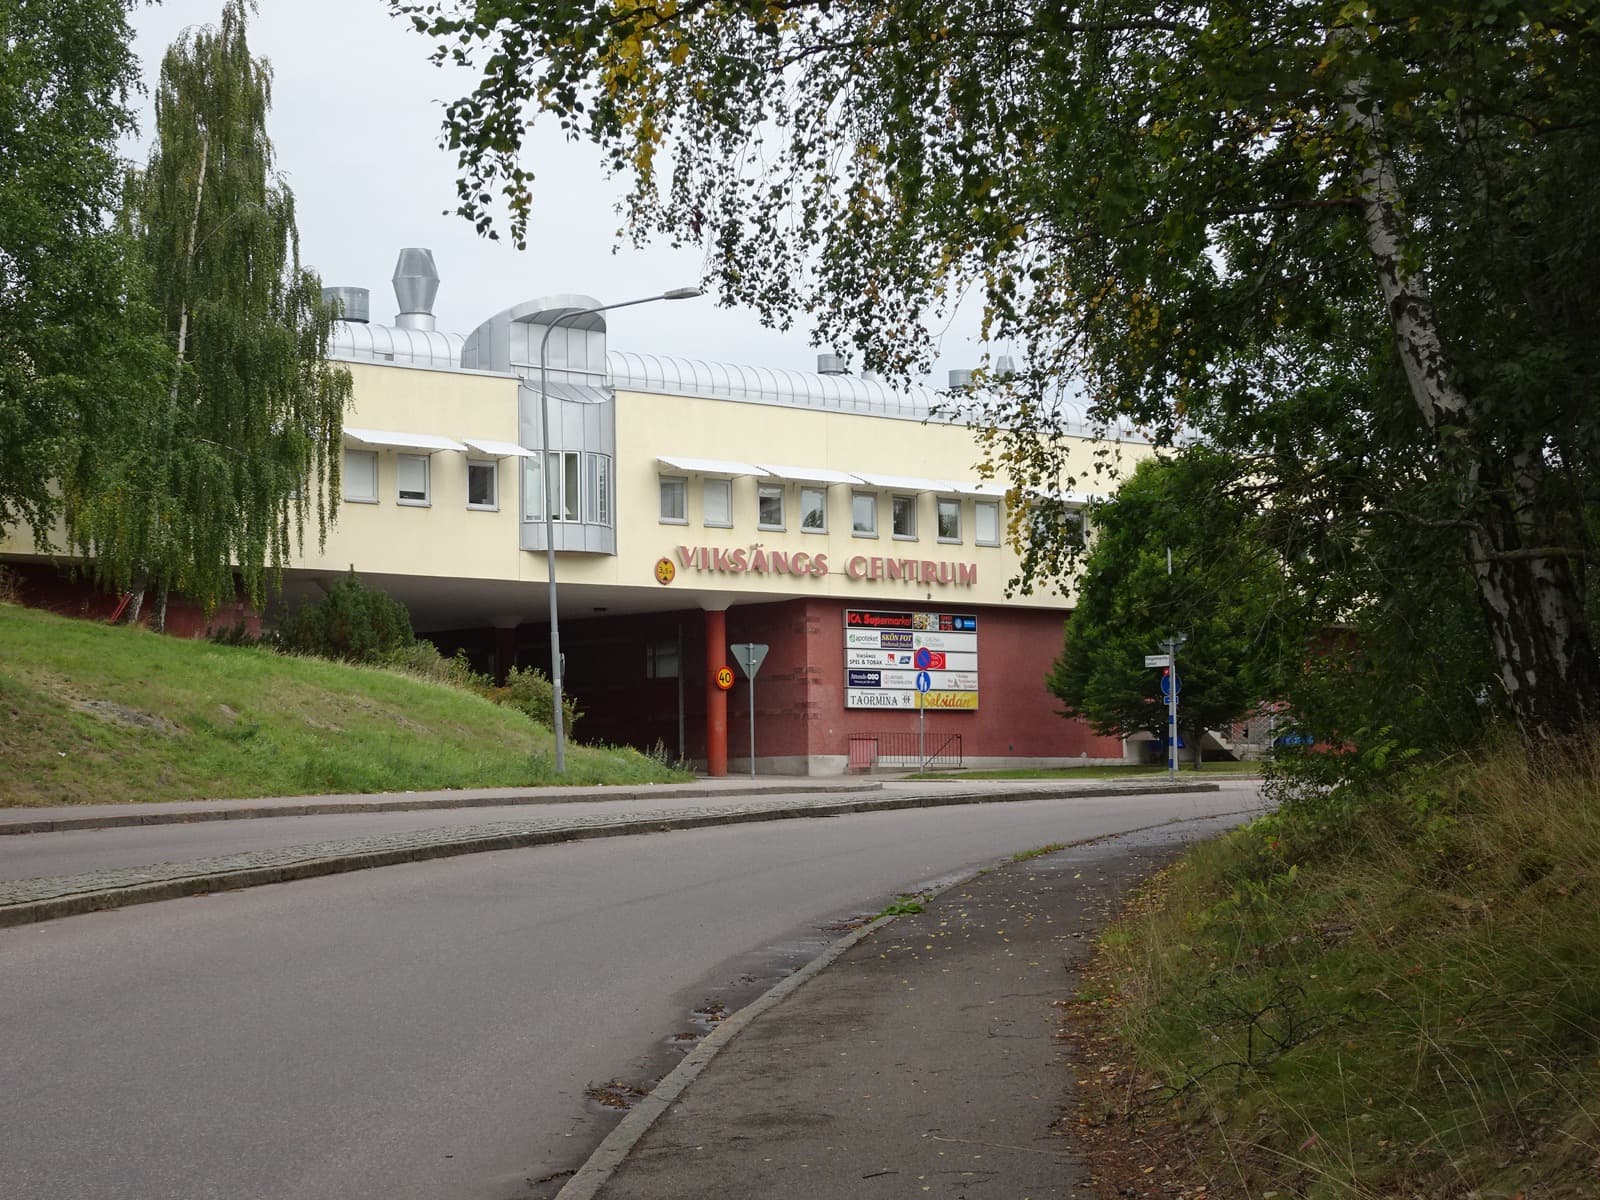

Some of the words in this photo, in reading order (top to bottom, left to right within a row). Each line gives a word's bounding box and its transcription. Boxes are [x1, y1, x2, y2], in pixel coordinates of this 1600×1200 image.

[677, 543, 829, 577] VIKSÄNGS
[846, 556, 977, 585] CENTRUM
[864, 613, 912, 627] Supermarket
[881, 632, 899, 641] SKÖN
[719, 672, 731, 683] 40
[850, 695, 898, 706] TAORMINA
